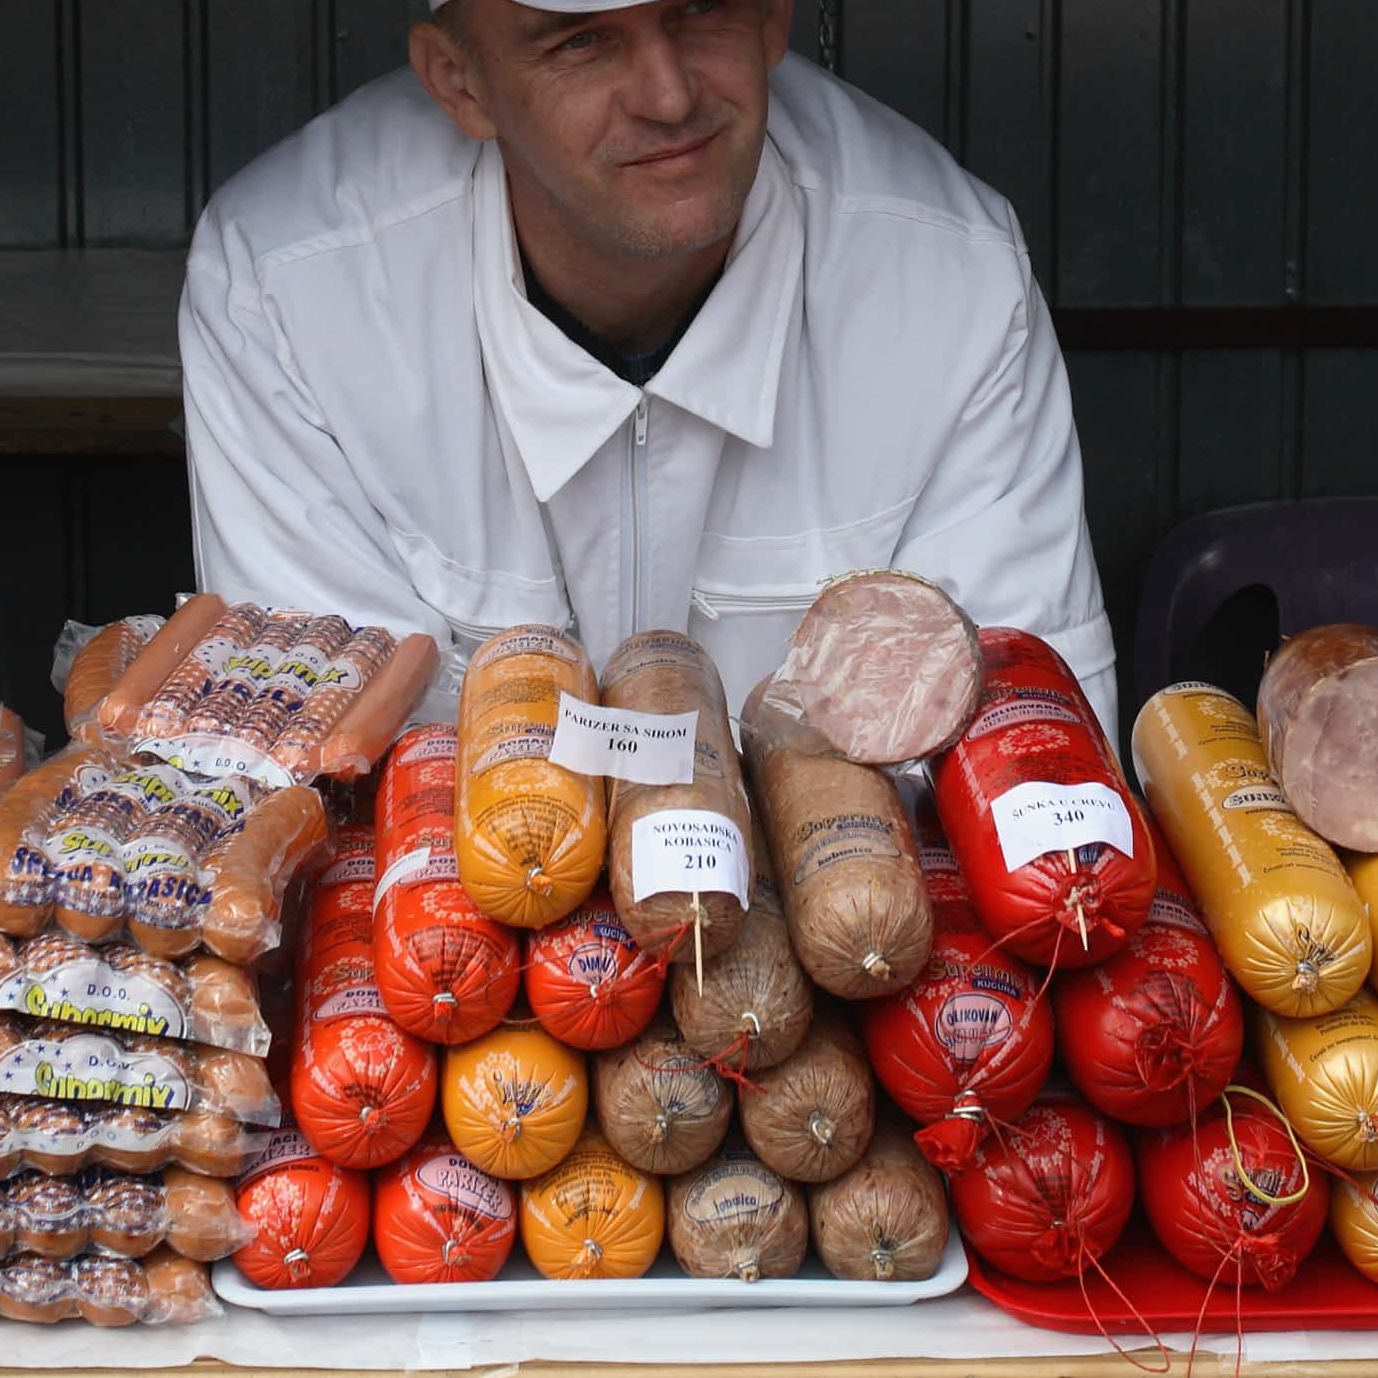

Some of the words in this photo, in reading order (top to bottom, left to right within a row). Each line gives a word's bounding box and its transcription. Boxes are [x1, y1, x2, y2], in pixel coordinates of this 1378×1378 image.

[565, 709, 620, 733] PARIZER
[622, 723, 640, 736] SA
[644, 727, 688, 740] SIROM
[608, 738, 639, 755] 160
[1011, 798, 1056, 820] ŠUNKA
[1071, 798, 1117, 812] CREVU
[1052, 809, 1085, 827] 340
[653, 822, 739, 845] NOVOSADSKA
[663, 836, 733, 853] KOBASICA
[684, 853, 717, 870] 210
[87, 983, 131, 1001] D.O.O.
[437, 1170, 504, 1214] PARIZER
